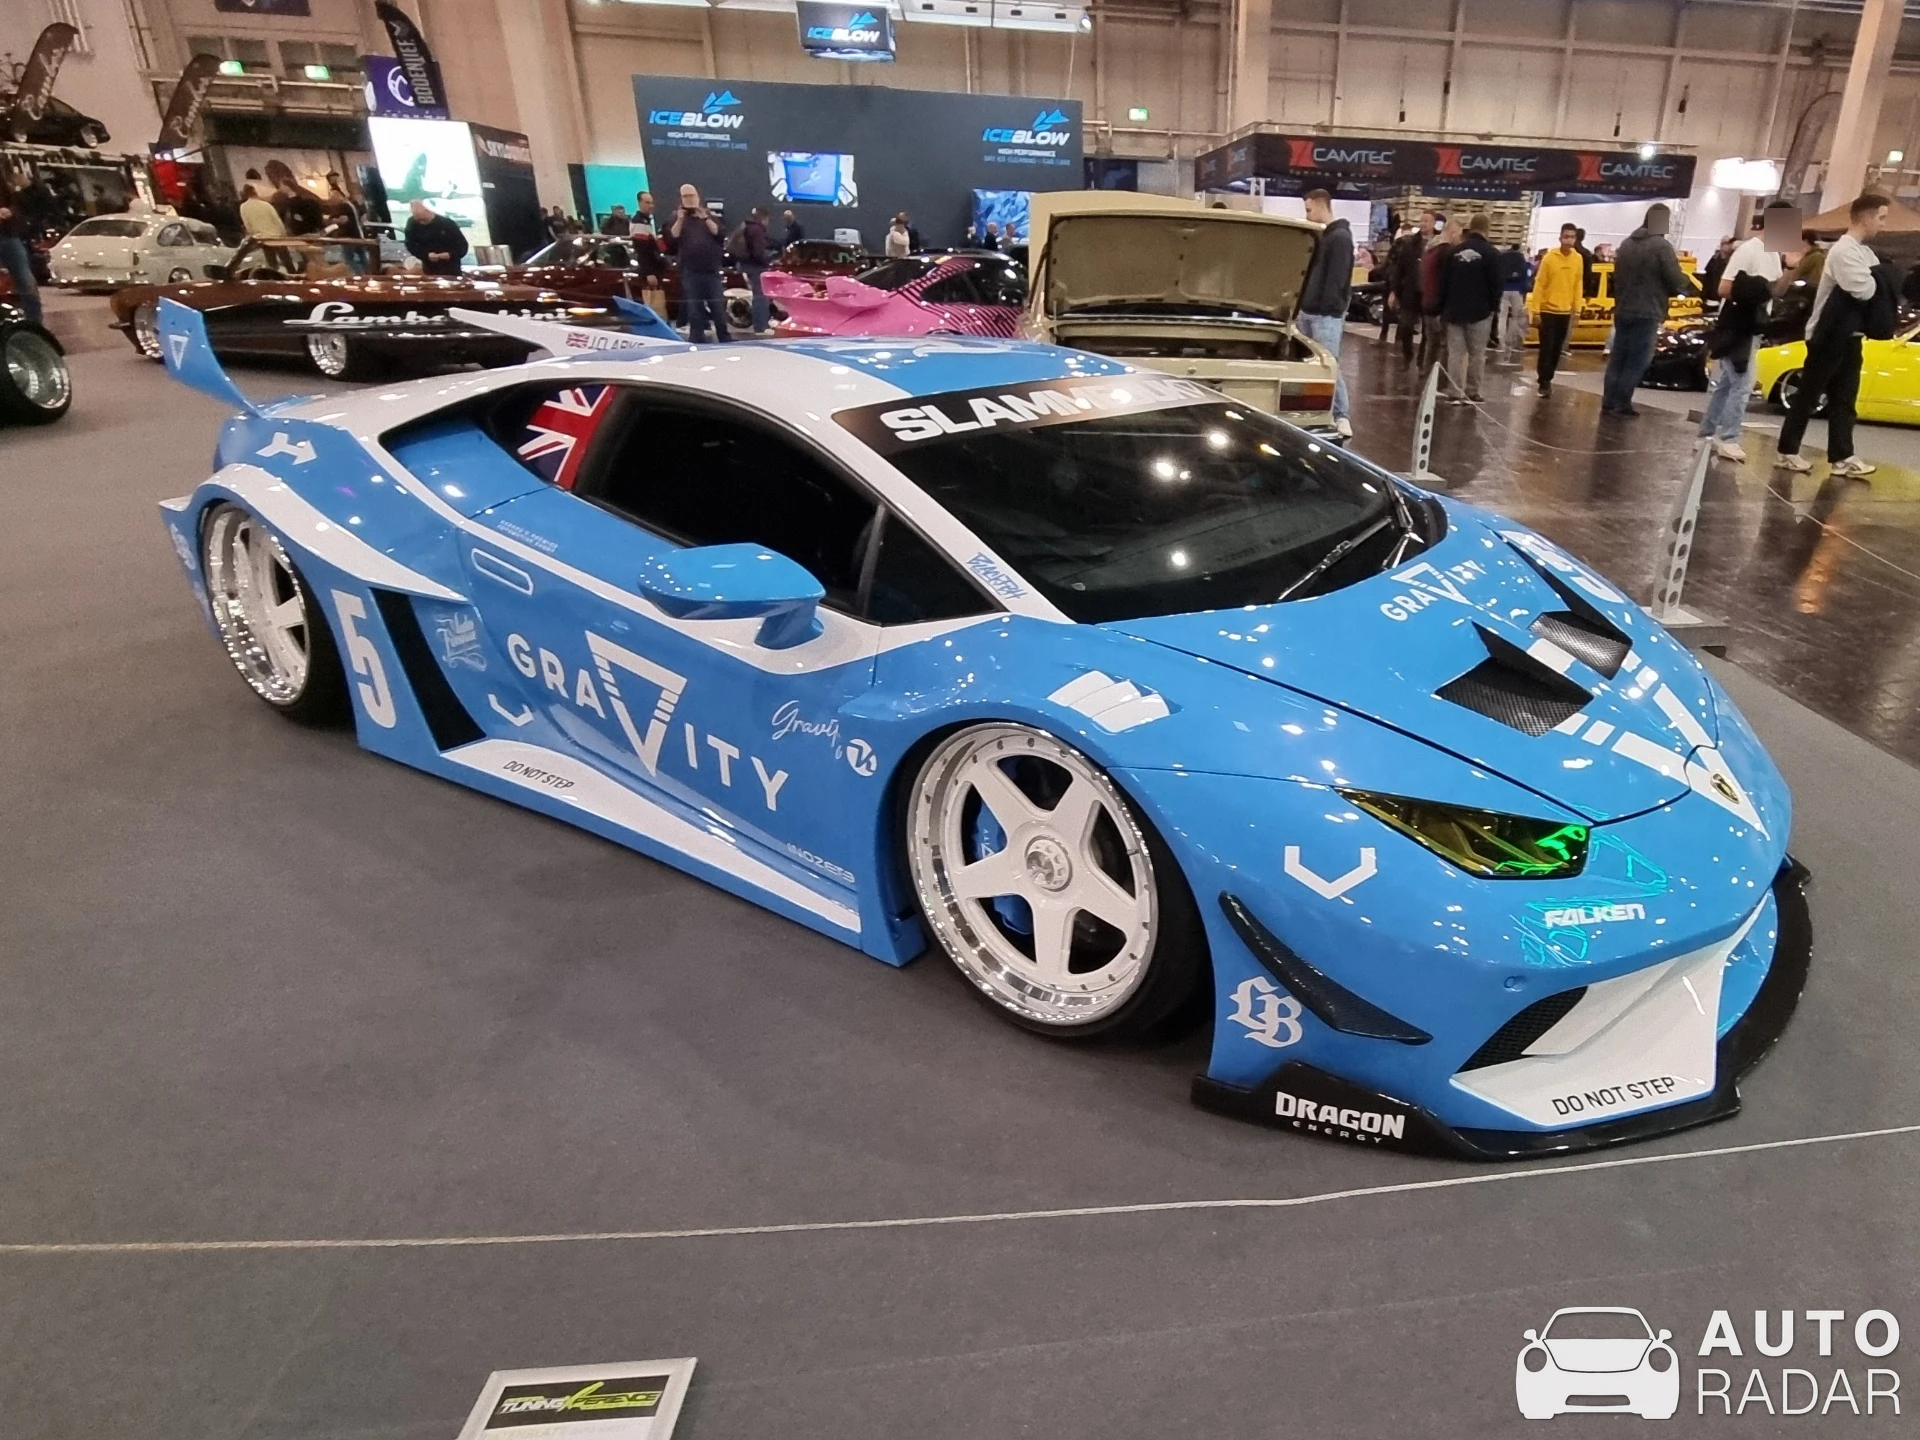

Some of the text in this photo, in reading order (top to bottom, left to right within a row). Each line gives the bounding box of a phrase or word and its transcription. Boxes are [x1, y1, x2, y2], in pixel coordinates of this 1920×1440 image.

[807, 27, 880, 42] ICEBLOW
[649, 111, 744, 128] ICEBLOW
[982, 128, 1070, 146] ICEBLOW
[1313, 148, 1393, 164] CAMTEC
[1460, 155, 1537, 171] CAMTEC
[1600, 162, 1675, 178] CAMTEC
[283, 302, 573, 324] Lambohini
[1380, 560, 1487, 621] GRAVITY
[331, 588, 397, 729] 5
[507, 630, 789, 812] GRAVITY
[503, 761, 575, 789] DO NOT STEP
[1545, 904, 1645, 929] FALKEN
[1552, 1077, 1675, 1115] DO NOT STEP
[1275, 1091, 1405, 1139] DRAGON
